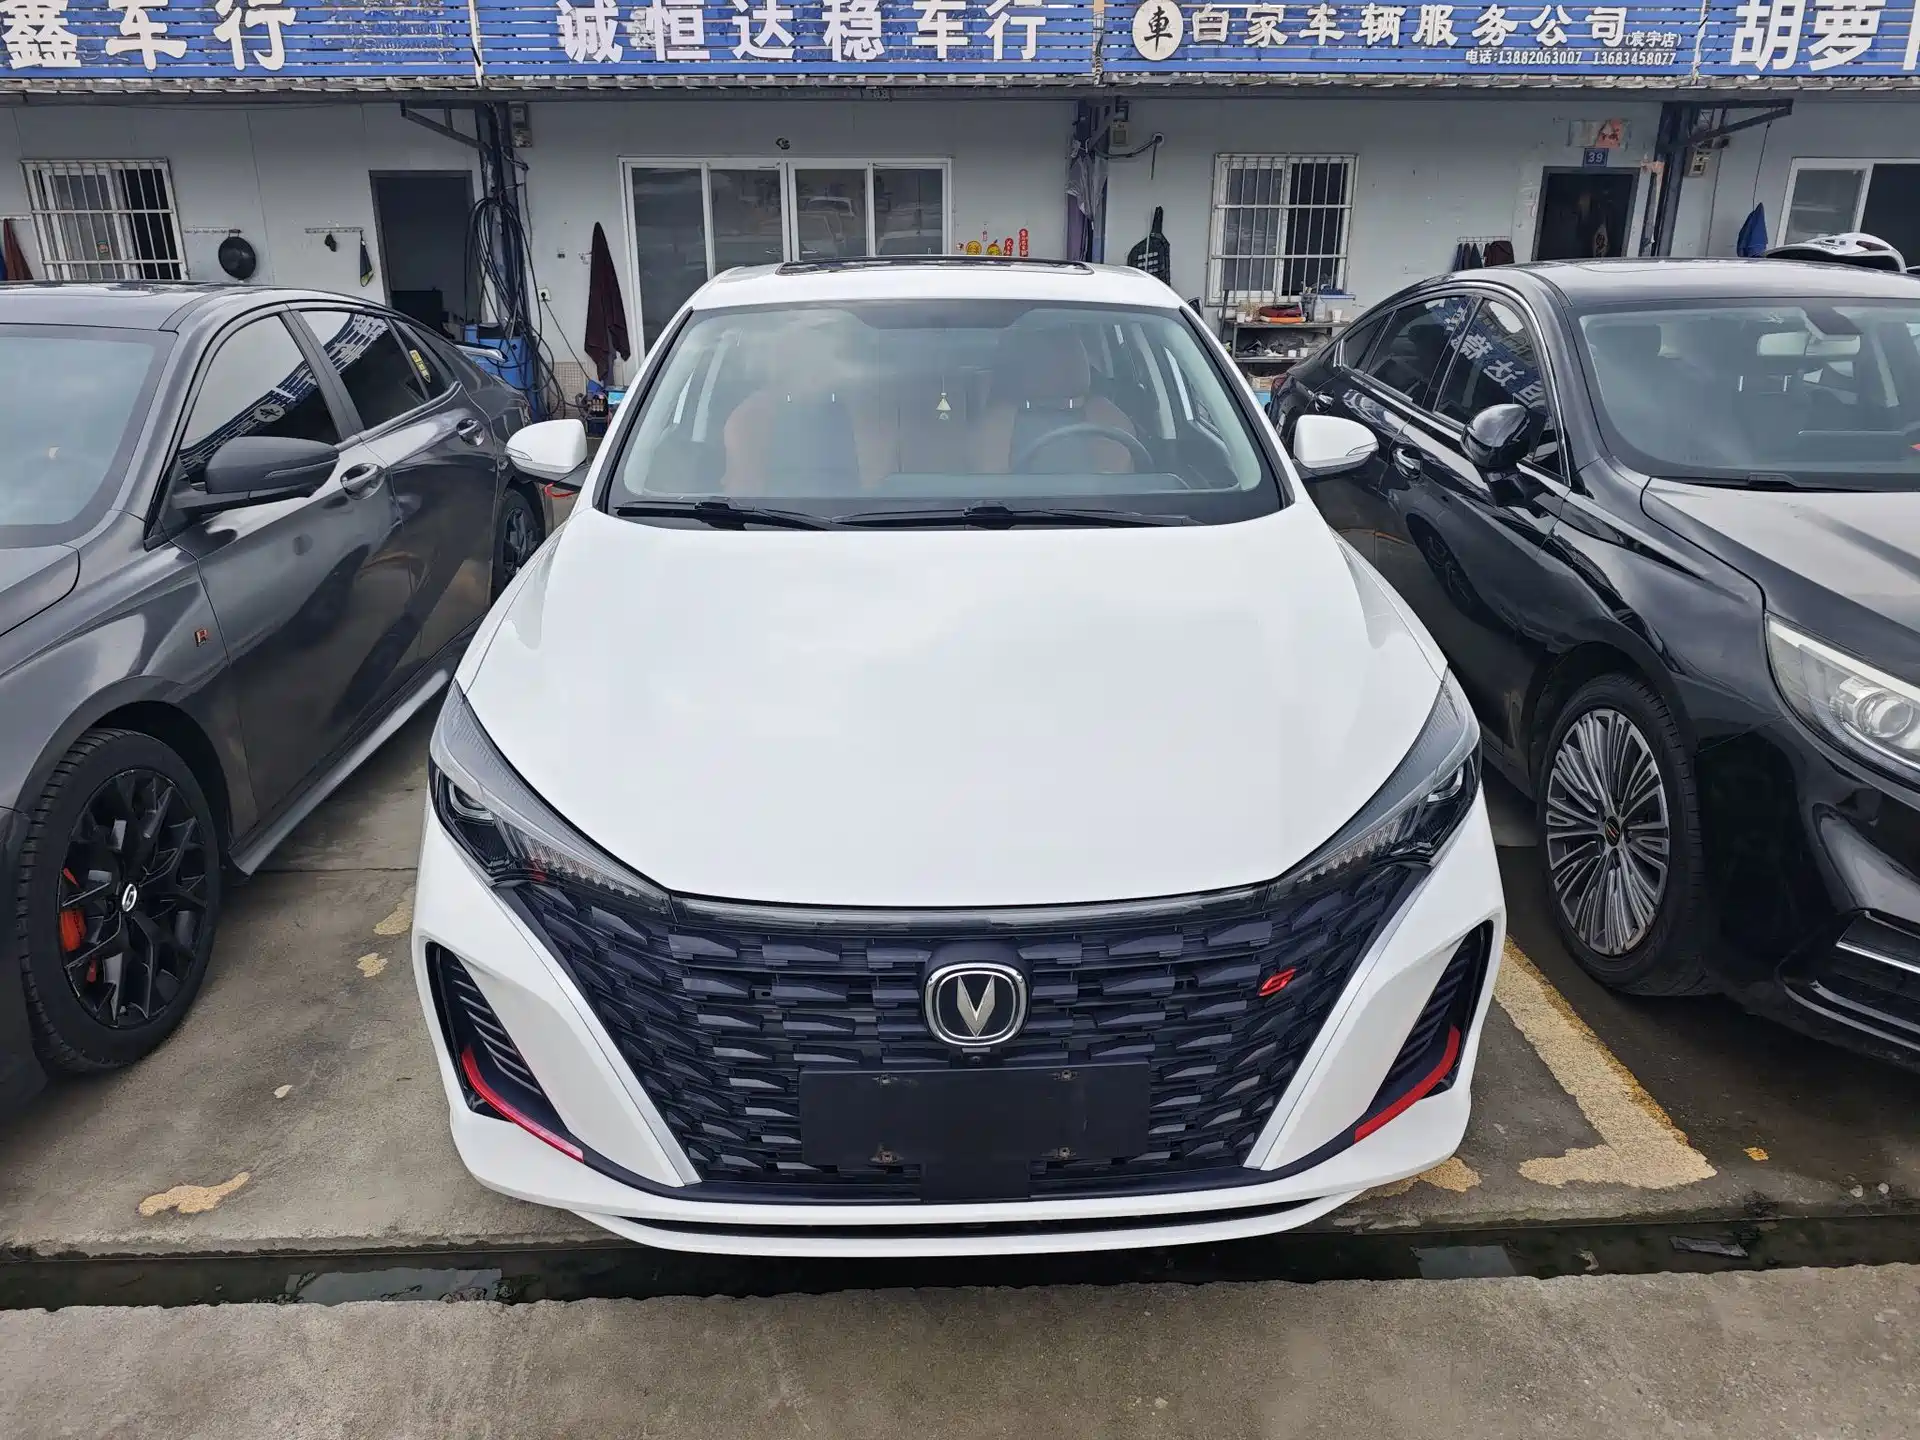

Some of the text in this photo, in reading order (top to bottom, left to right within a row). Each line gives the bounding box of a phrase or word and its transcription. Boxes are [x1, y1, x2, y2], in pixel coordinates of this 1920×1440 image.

[556, 0, 1046, 64] 诚恒达稳车行
[1592, 51, 1677, 66] 13683458077
